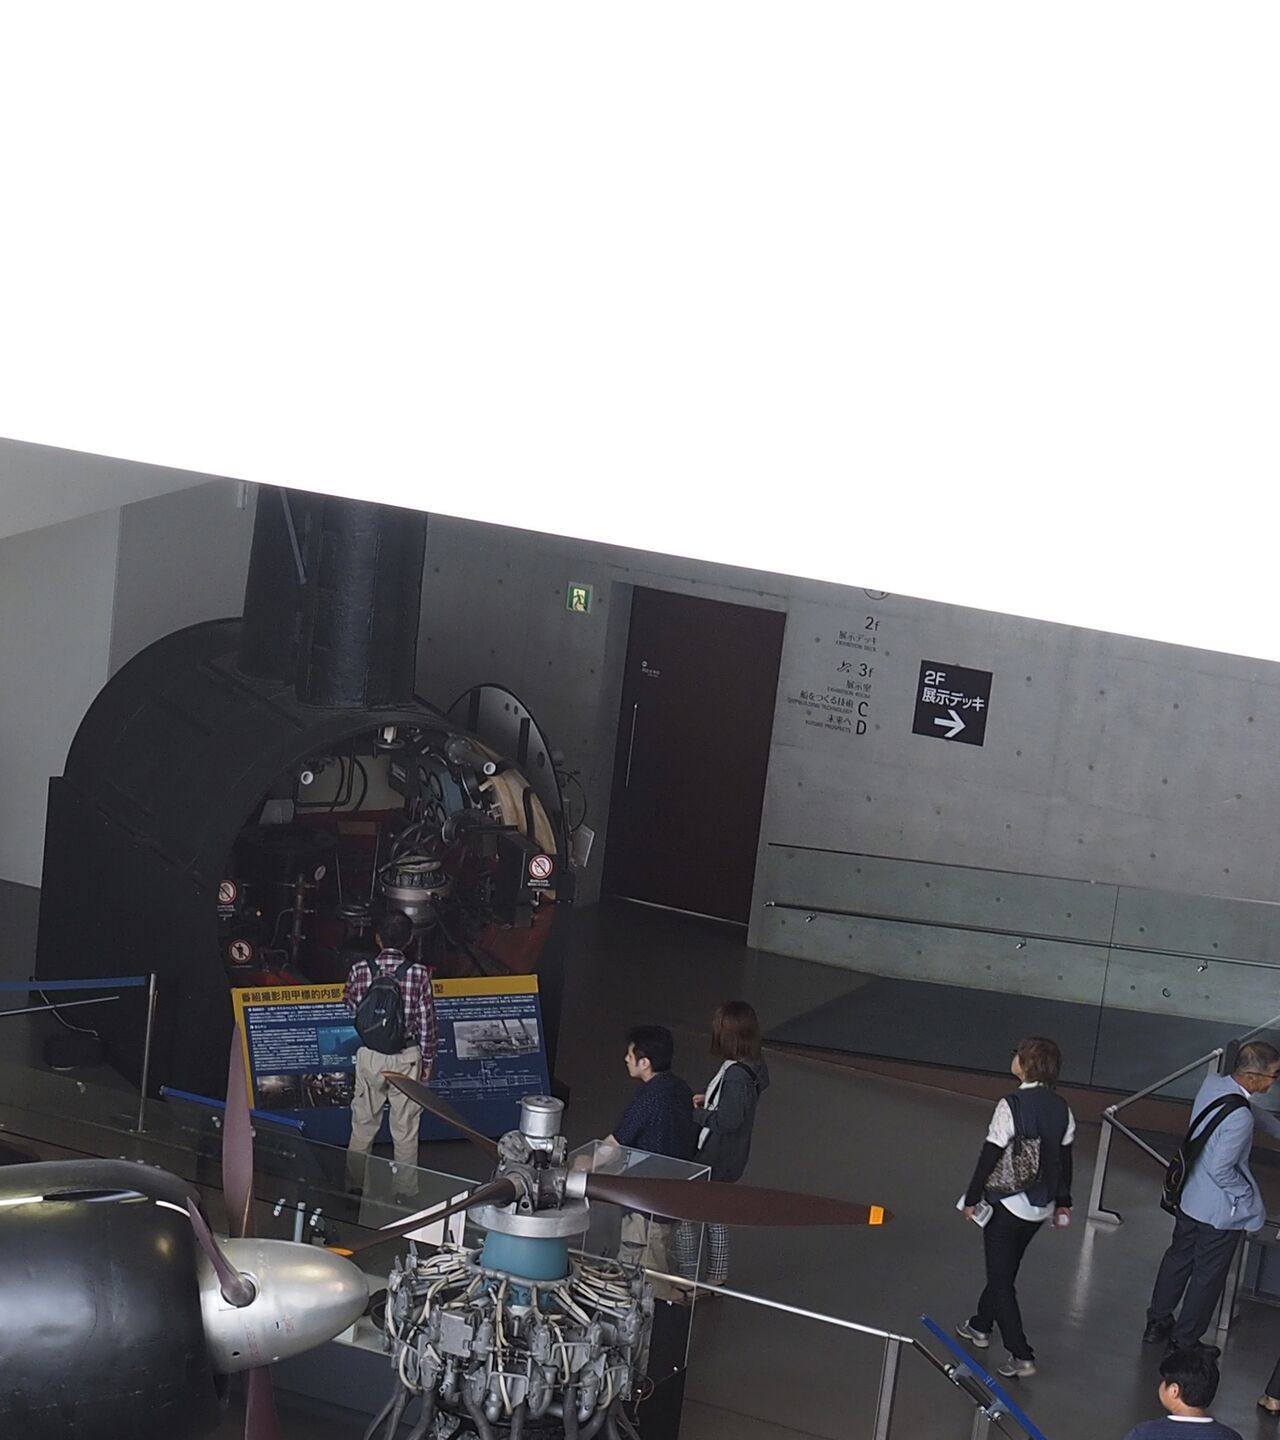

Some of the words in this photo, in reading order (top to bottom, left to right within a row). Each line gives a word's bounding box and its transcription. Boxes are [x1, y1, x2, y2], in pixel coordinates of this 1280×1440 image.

[924, 670, 946, 686] 2F
[921, 686, 985, 712] 展示デッキ
[858, 701, 869, 717] C
[856, 720, 867, 735] D
